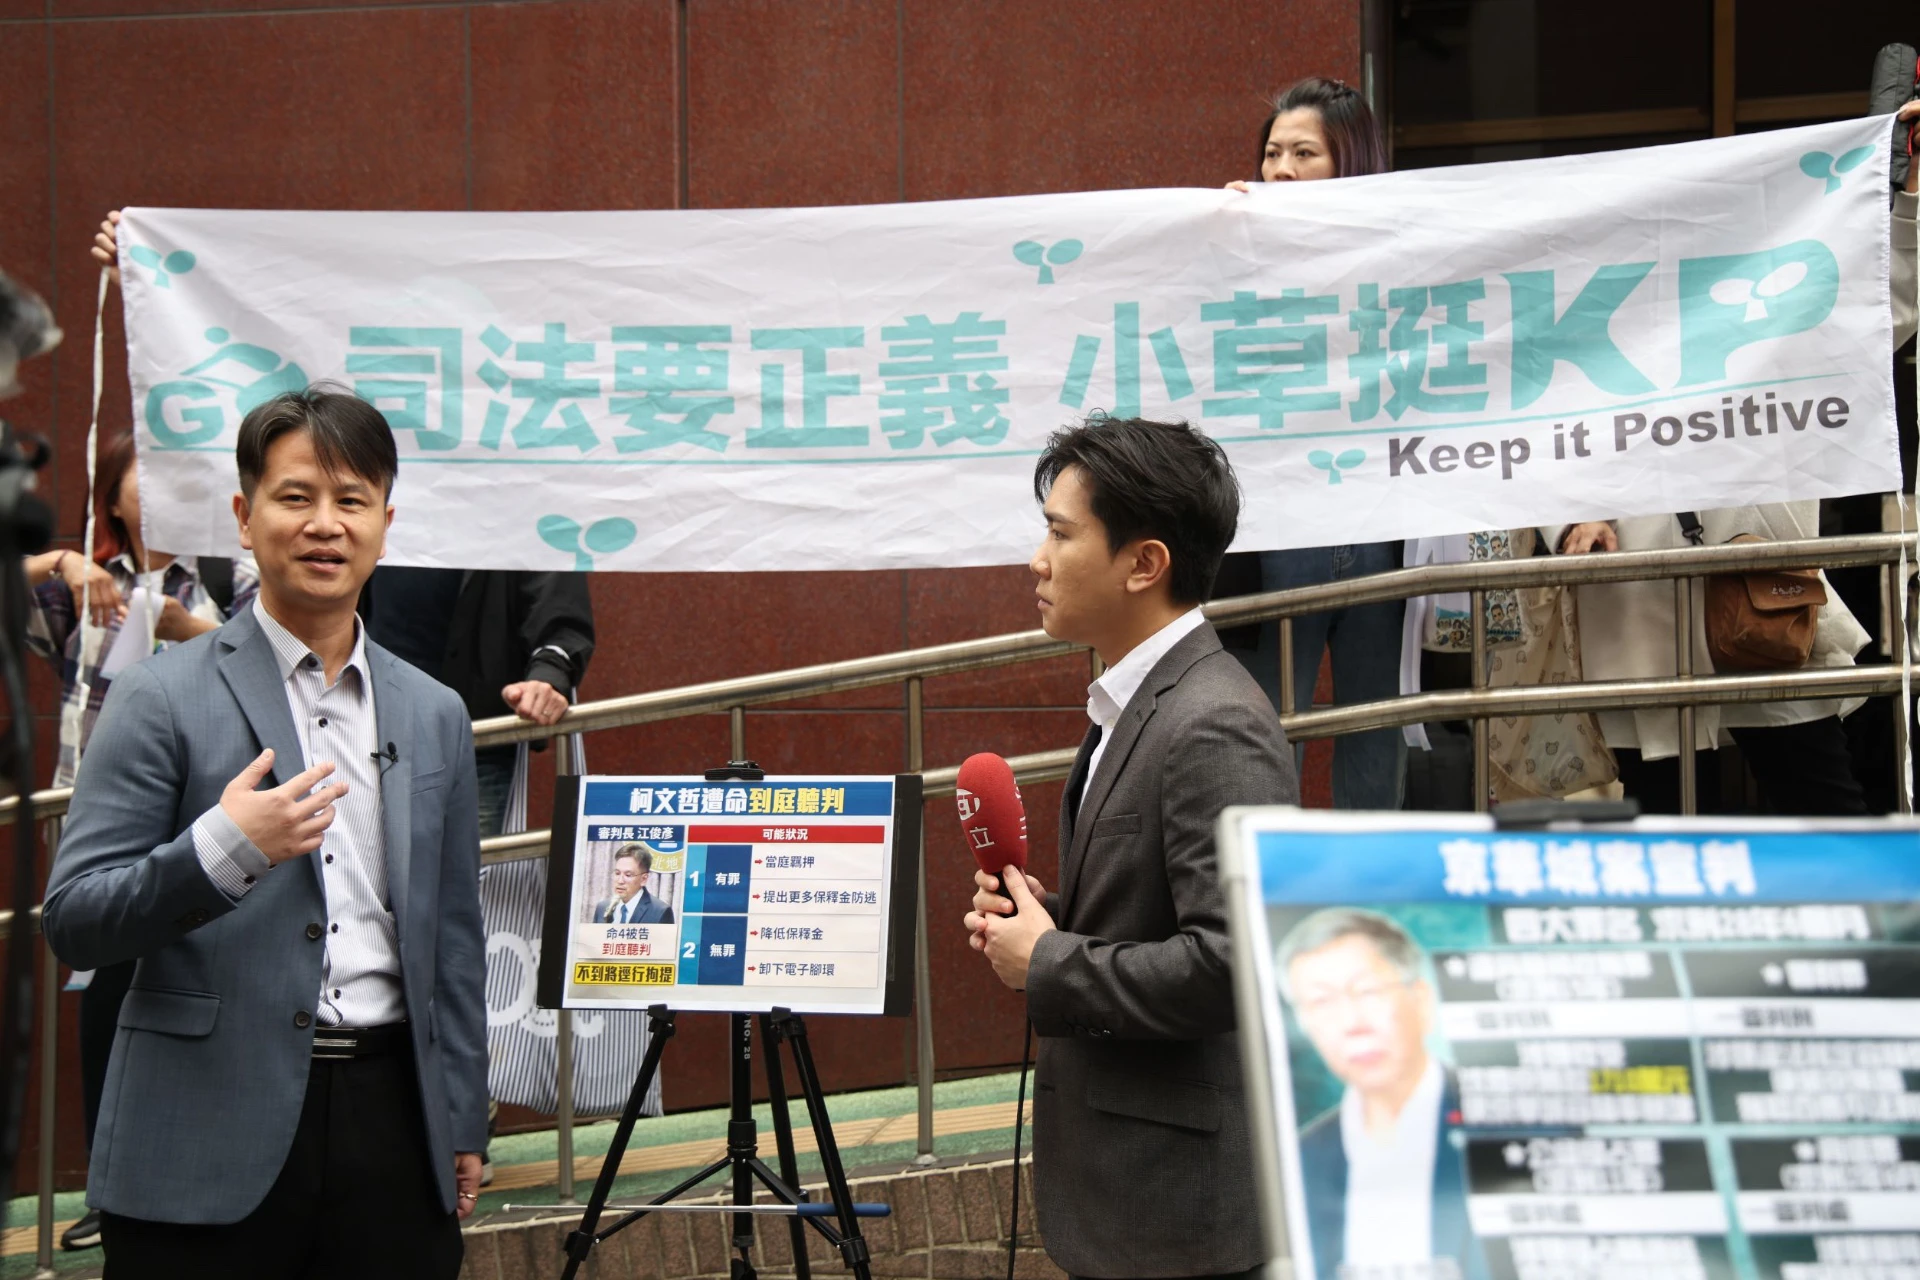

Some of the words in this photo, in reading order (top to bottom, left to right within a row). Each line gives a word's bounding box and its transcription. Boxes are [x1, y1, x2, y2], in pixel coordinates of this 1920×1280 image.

[345, 312, 1011, 454] 司法要正義
[1388, 434, 1532, 480] Keep
[1553, 421, 1592, 461] it
[1614, 392, 1851, 452] Positive
[629, 787, 845, 814] 柯文哲遭命到庭聽判
[598, 826, 634, 840] 審判長
[762, 827, 809, 841] 可能狀況
[765, 855, 815, 869] 當庭羈押
[689, 870, 700, 887] 1
[715, 872, 741, 886] 有罪
[763, 890, 877, 904] 提出更多保釋金防逃
[606, 927, 650, 940] 命4被告
[760, 926, 824, 941] 降低保釋金
[602, 943, 652, 957] 到庭聽判
[682, 941, 696, 958] 2
[709, 943, 736, 958] 無罪
[576, 965, 673, 983] 不到將逕行拘提
[758, 962, 835, 977] 卸下電子腳環
